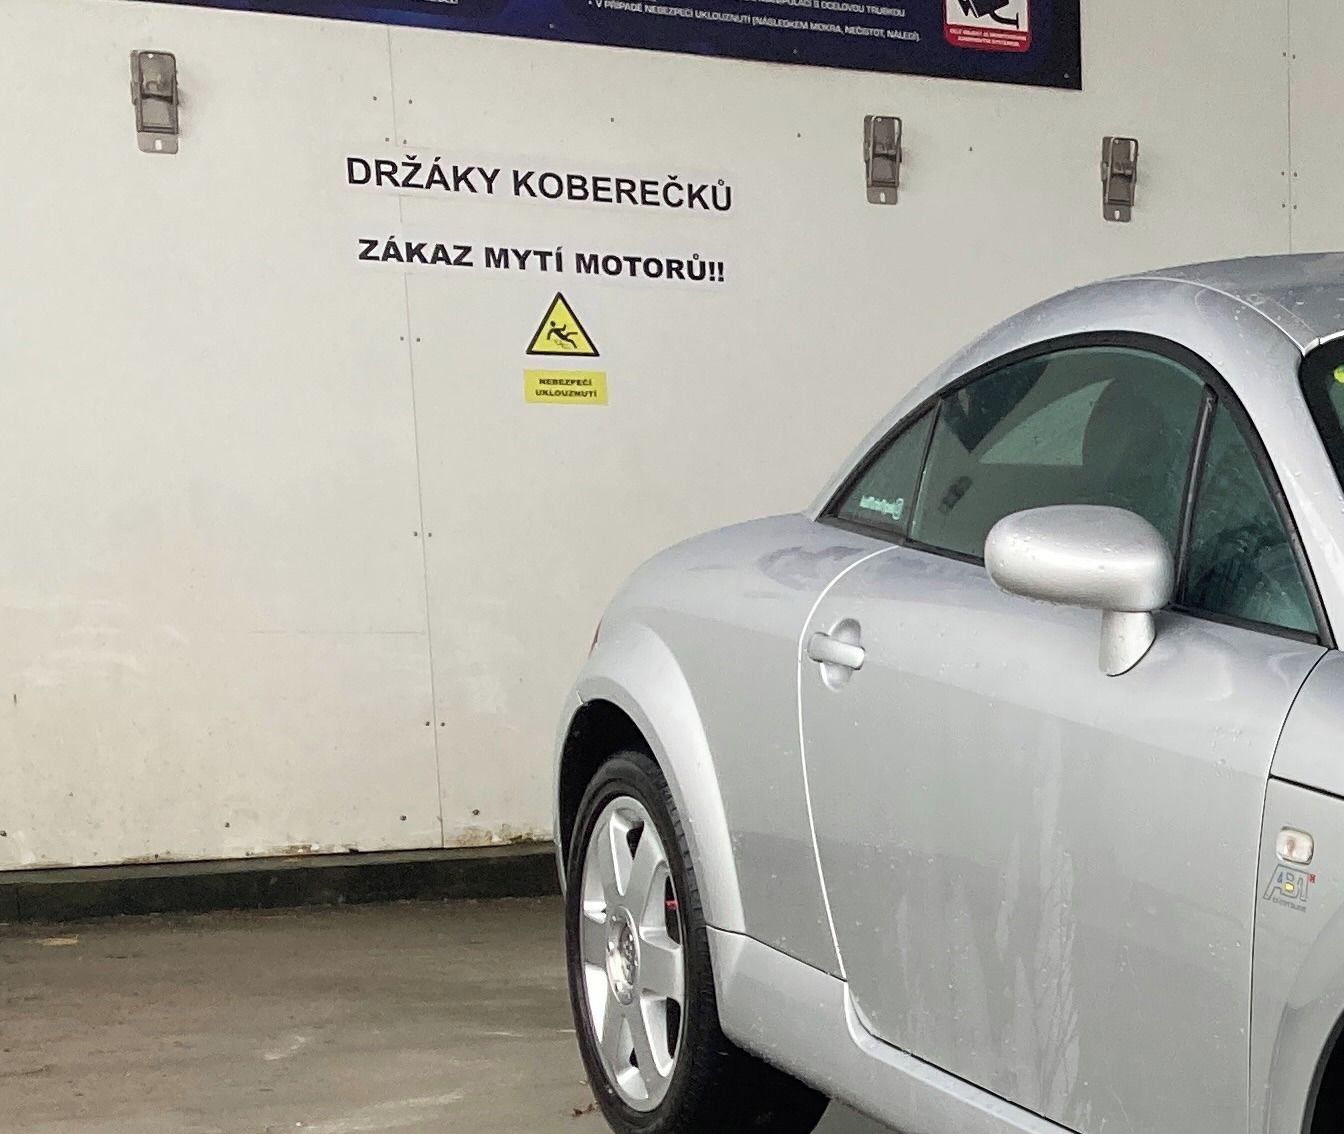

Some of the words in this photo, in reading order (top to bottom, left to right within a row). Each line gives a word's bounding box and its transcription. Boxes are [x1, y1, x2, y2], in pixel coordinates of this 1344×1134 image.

[346, 154, 501, 196] DRŽÁKY
[512, 168, 733, 212] KOBEREČKŮ
[358, 235, 474, 268] ZÁKAZ
[484, 246, 563, 273] MYTÍ
[575, 253, 725, 282] MOTORŮ!!
